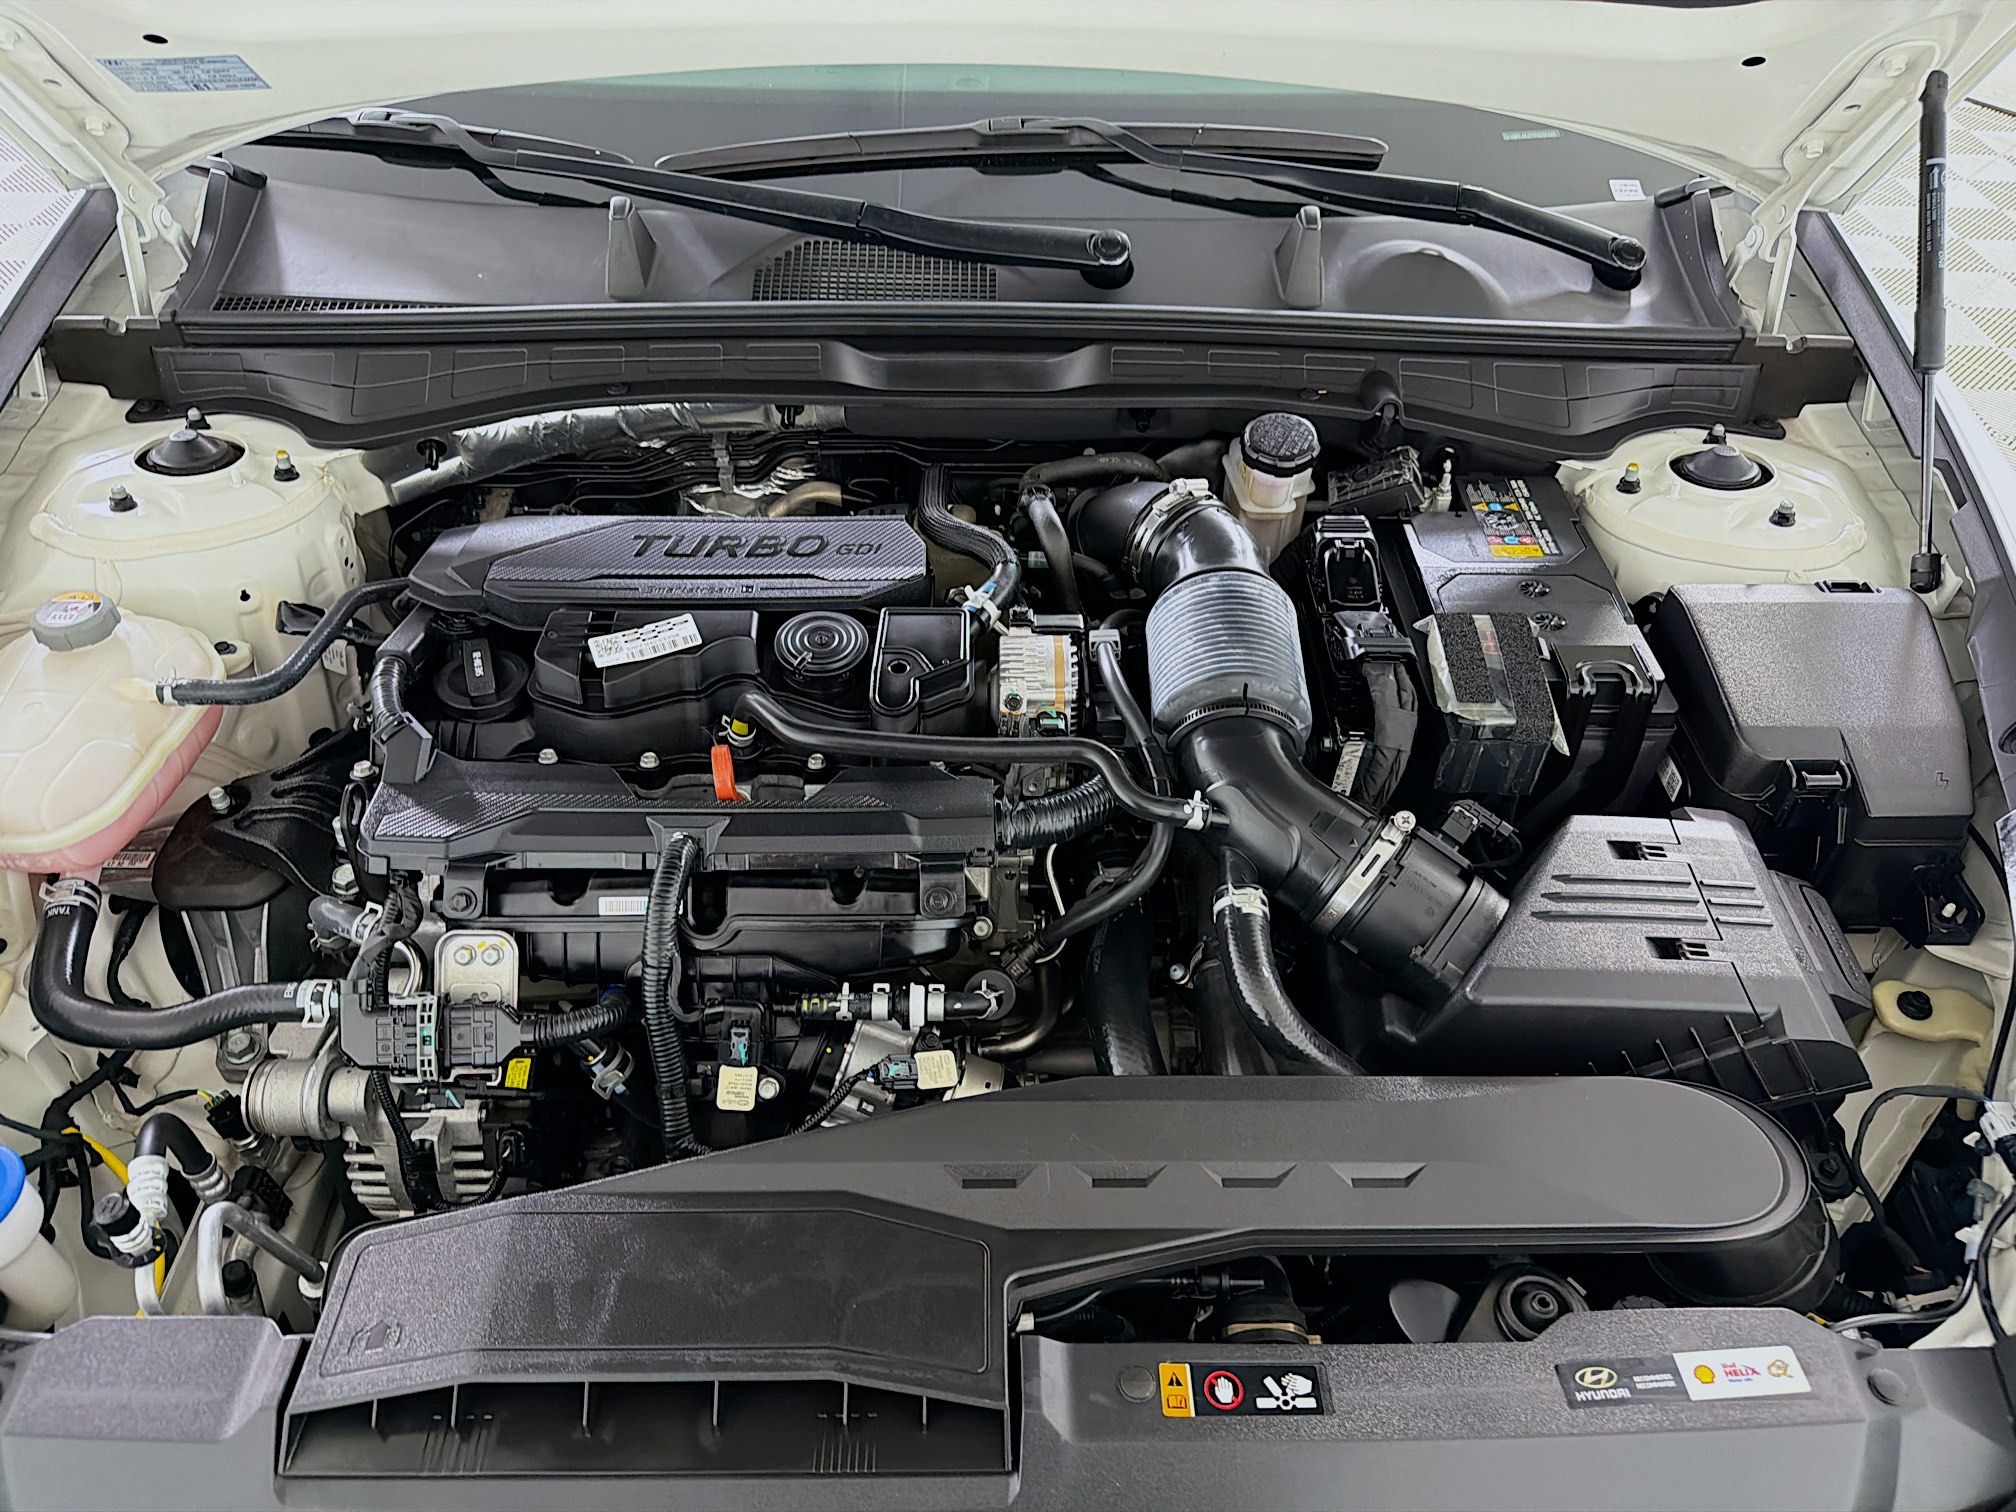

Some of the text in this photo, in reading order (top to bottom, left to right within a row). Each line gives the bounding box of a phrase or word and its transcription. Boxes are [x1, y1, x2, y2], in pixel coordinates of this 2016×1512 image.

[632, 534, 883, 558] TURBO GDI
[46, 905, 71, 918] TANK
[1723, 1364, 1762, 1378] HELIX
[1574, 1387, 1632, 1402] HYUNDAI
